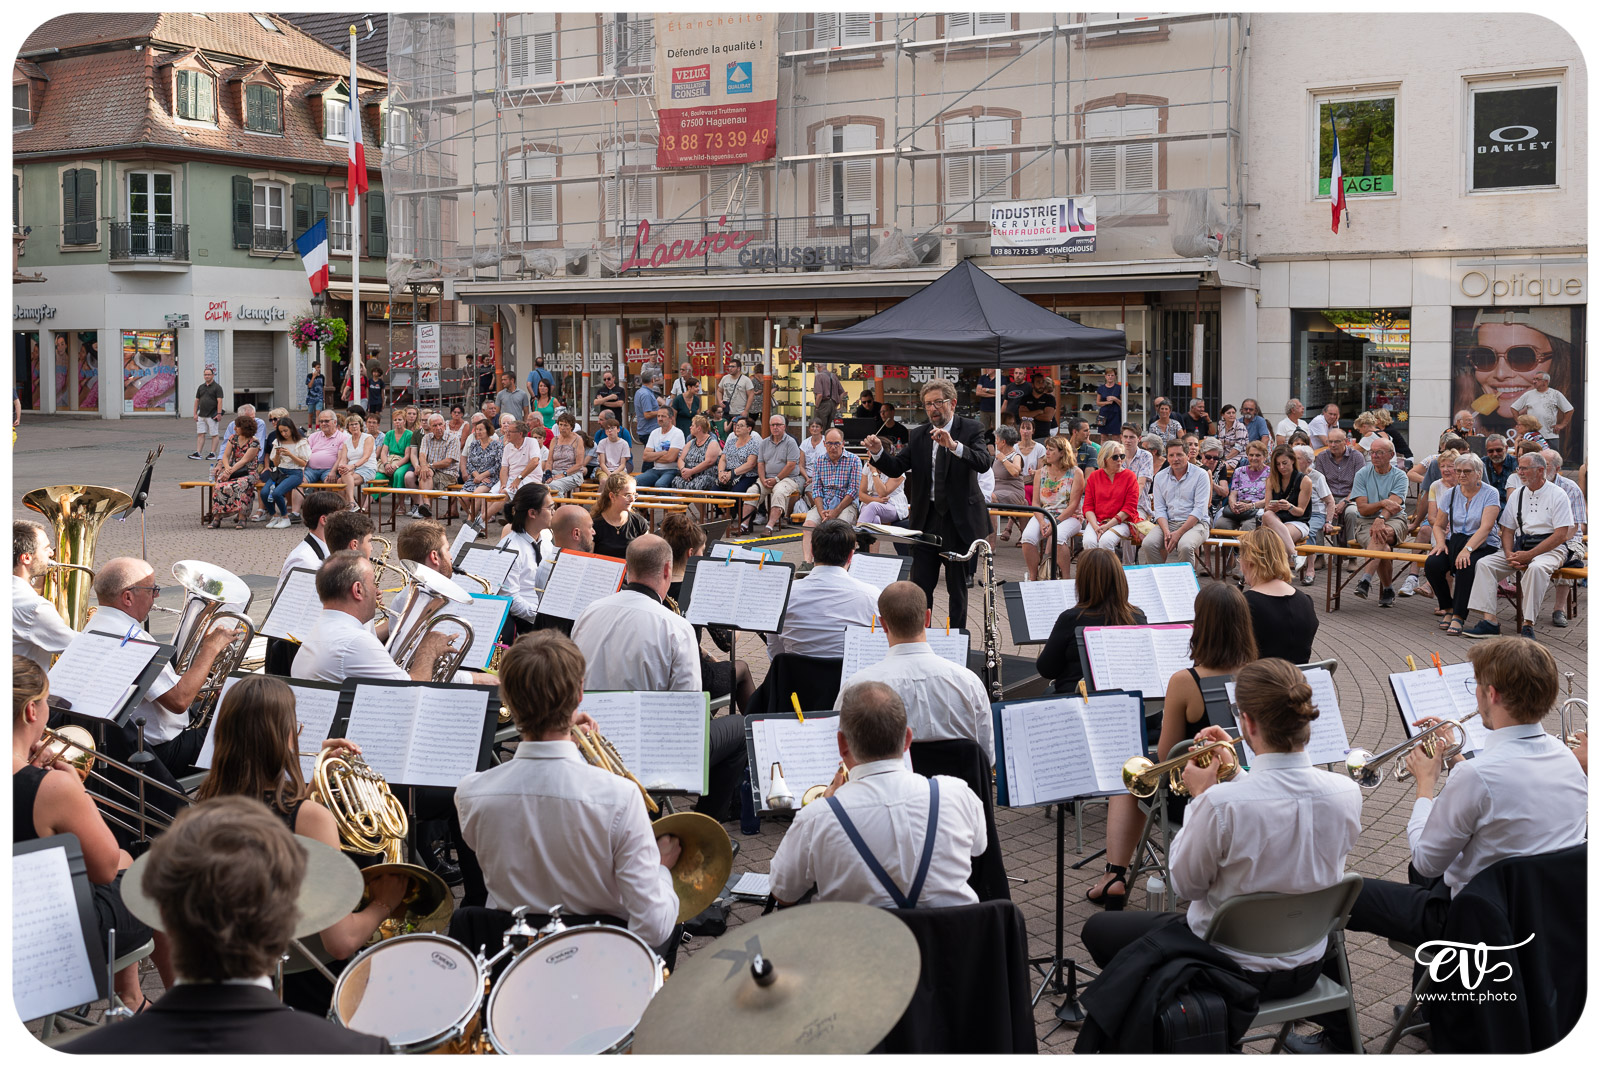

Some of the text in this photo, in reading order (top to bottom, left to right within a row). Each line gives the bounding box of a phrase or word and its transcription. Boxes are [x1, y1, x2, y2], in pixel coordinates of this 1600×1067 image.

[668, 13, 763, 32] Étanchéité
[667, 40, 763, 58] Défendre la qualité !
[675, 81, 707, 90] INSTALLATEUR
[675, 88, 707, 98] CONSEIL
[690, 109, 718, 117] Boulevard
[681, 116, 747, 128] 67500 Haguenau
[681, 134, 698, 150] 88
[704, 133, 723, 149] 73
[728, 131, 747, 147] 39
[752, 128, 769, 145] 49
[1478, 141, 1551, 154] OAKLEY
[680, 152, 748, 162] www.hild-haguenau.com
[1343, 177, 1382, 192] AGE
[992, 205, 1057, 220] INDUSTRIE
[621, 215, 755, 272] Lacroix
[1044, 245, 1093, 254] SCHWEIGHOUSE
[738, 246, 853, 267] CHAUSSEUR
[1460, 271, 1582, 305] Optique
[208, 301, 228, 310] DON'T
[13, 304, 56, 323] Jennyfer
[205, 311, 232, 322] CALL ME
[237, 305, 287, 324] Jennyfer
[625, 348, 665, 363] OLDS
[686, 342, 732, 356] SOLDS
